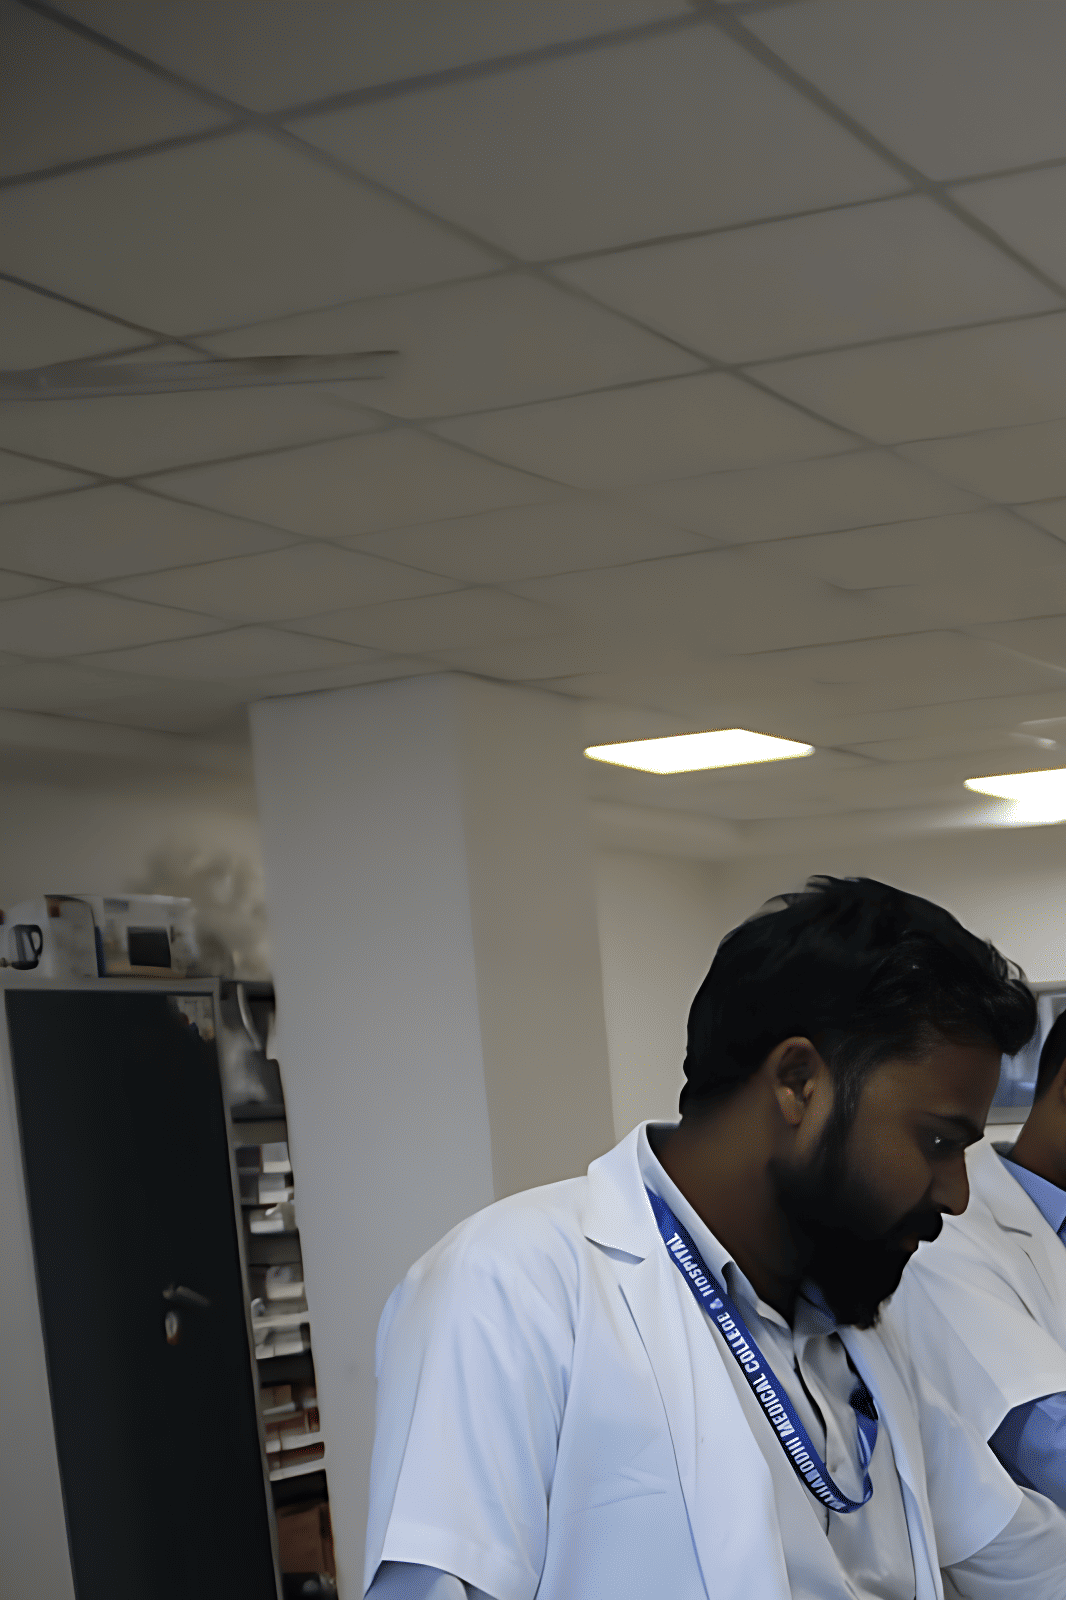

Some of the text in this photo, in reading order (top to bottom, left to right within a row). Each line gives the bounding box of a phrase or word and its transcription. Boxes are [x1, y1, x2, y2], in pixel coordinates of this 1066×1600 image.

[666, 1231, 715, 1297] HOSPITAL
[716, 1311, 760, 1374] COLLEGE
[752, 1372, 796, 1438] MEDICAL
